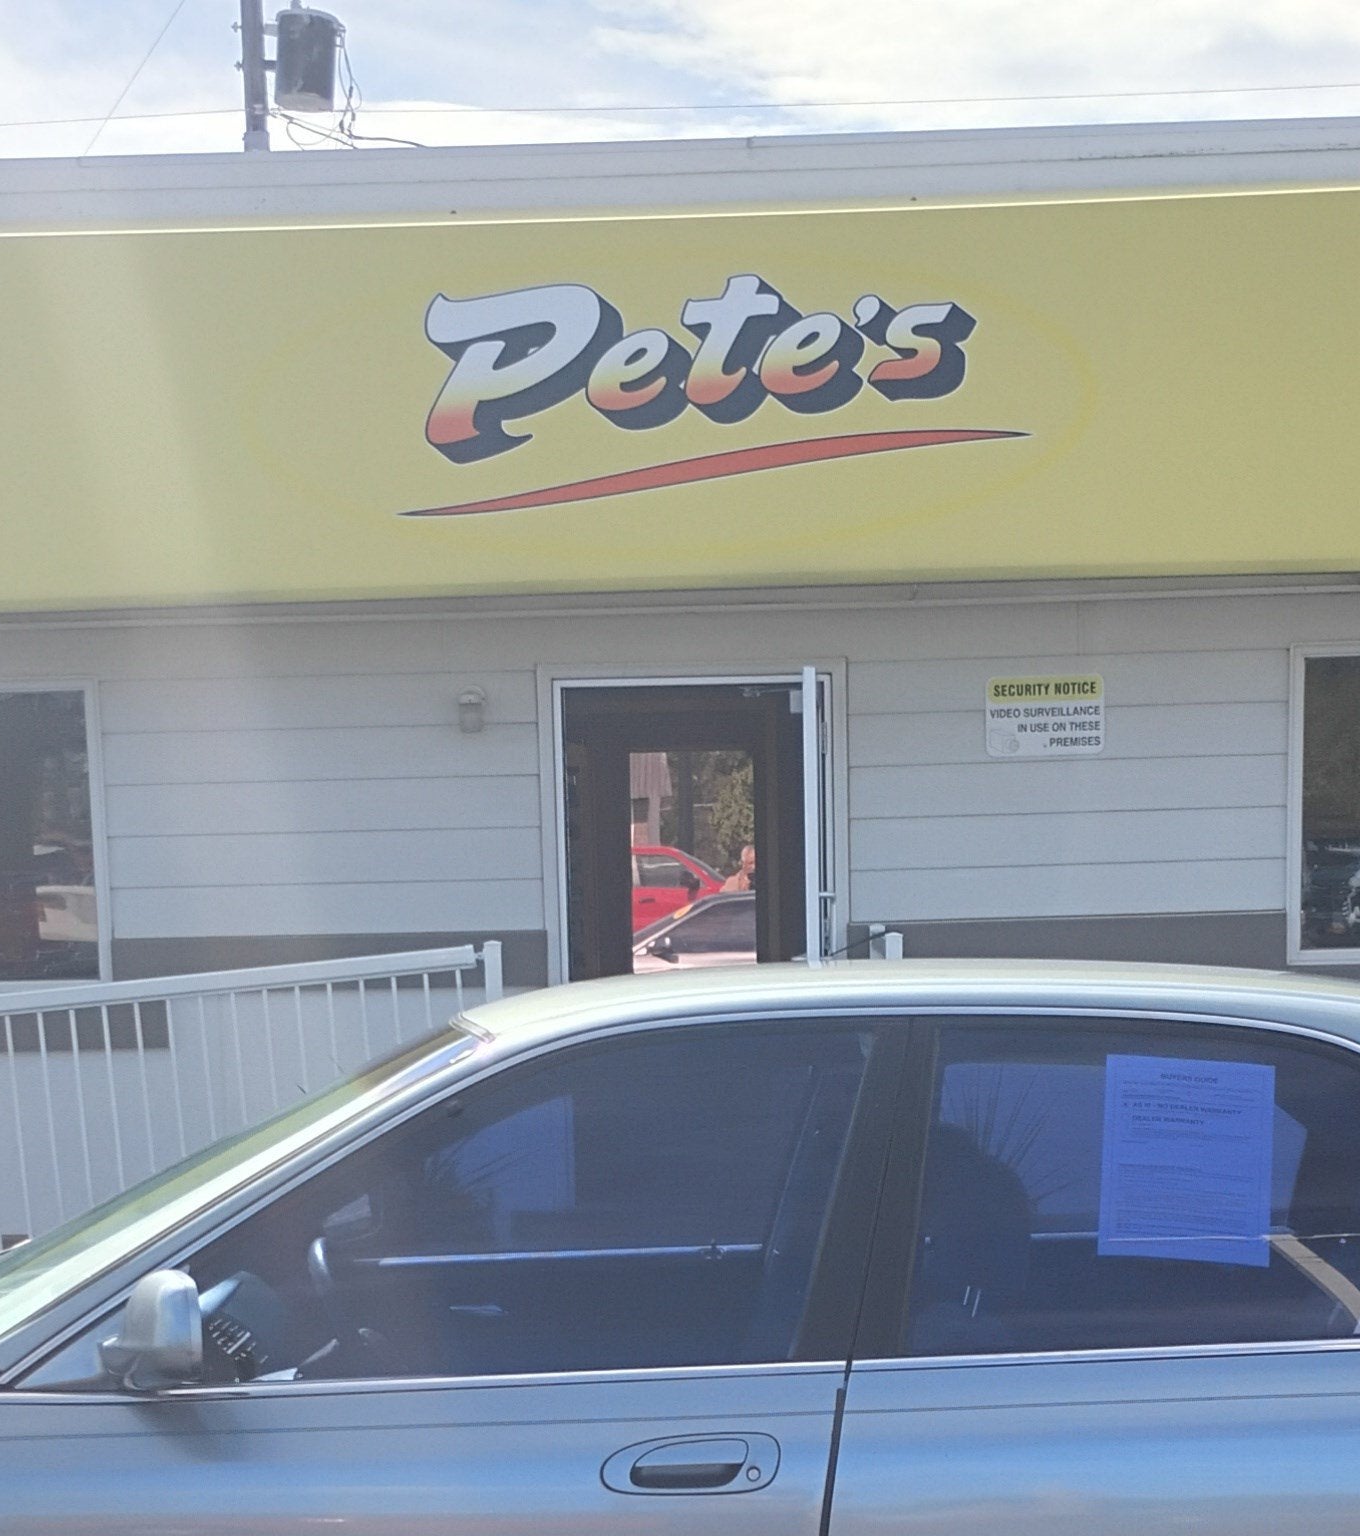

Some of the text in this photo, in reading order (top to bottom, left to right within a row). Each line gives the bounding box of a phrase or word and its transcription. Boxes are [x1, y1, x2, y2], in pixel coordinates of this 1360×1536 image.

[425, 274, 977, 464] Pete's
[993, 681, 1097, 696] SECURITY NOTICE
[990, 706, 1101, 718] VIDEO SURVEILLANCE
[1017, 721, 1101, 732] IN USE ON THESE
[1049, 736, 1101, 747] PREMISES
